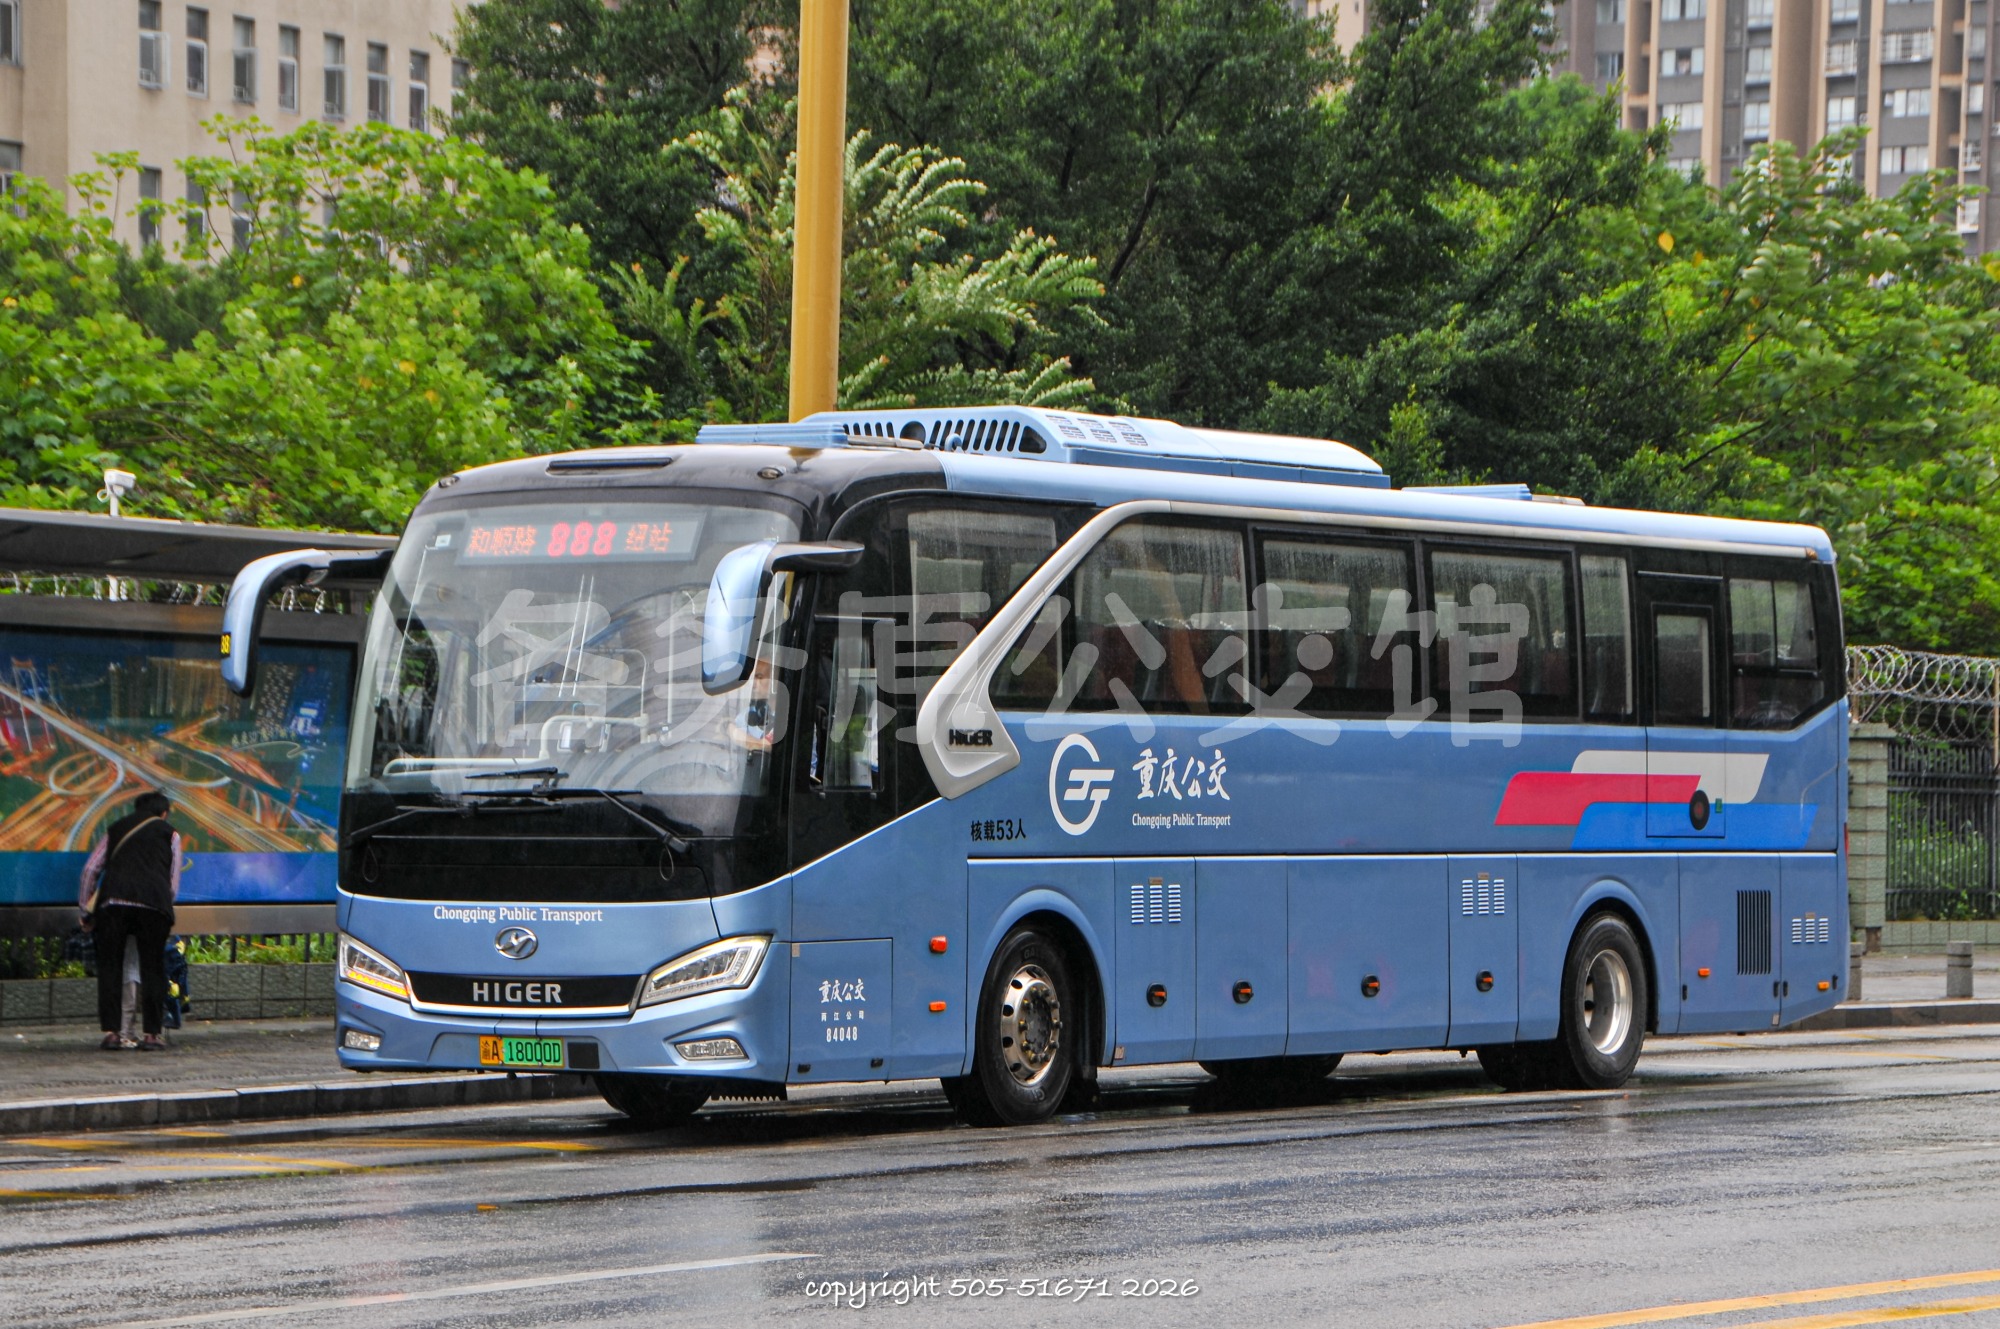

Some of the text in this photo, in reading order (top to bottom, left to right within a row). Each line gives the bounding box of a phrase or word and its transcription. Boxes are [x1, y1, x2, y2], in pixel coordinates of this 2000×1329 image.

[547, 520, 617, 557] 888
[1132, 747, 1231, 801] 重庆公交
[970, 817, 1027, 842] 核载53人
[1132, 813, 1231, 829] Chongqing Public Transport
[433, 905, 603, 925] Chongqing Public Transport
[472, 981, 563, 1004] HIGER
[818, 977, 866, 1004] 重庆公交
[826, 1025, 858, 1043] 84048
